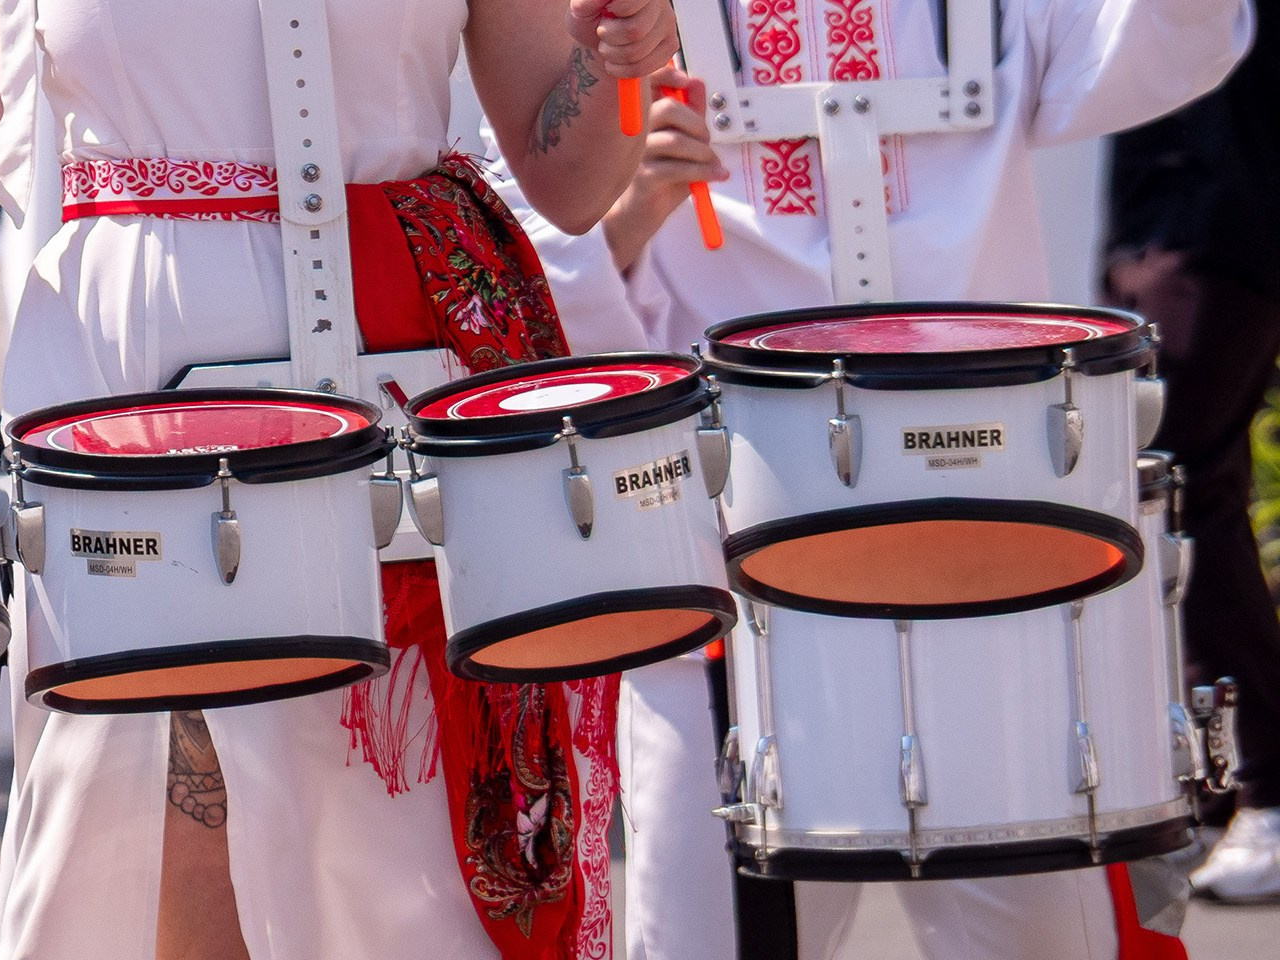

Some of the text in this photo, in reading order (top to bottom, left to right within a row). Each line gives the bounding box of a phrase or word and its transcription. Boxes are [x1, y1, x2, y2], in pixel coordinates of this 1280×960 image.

[903, 429, 1002, 450] BRAHNER
[615, 456, 691, 494] BRAHNER
[71, 534, 159, 555] BRAHNER
[89, 564, 133, 574] MSD-04H/WH
